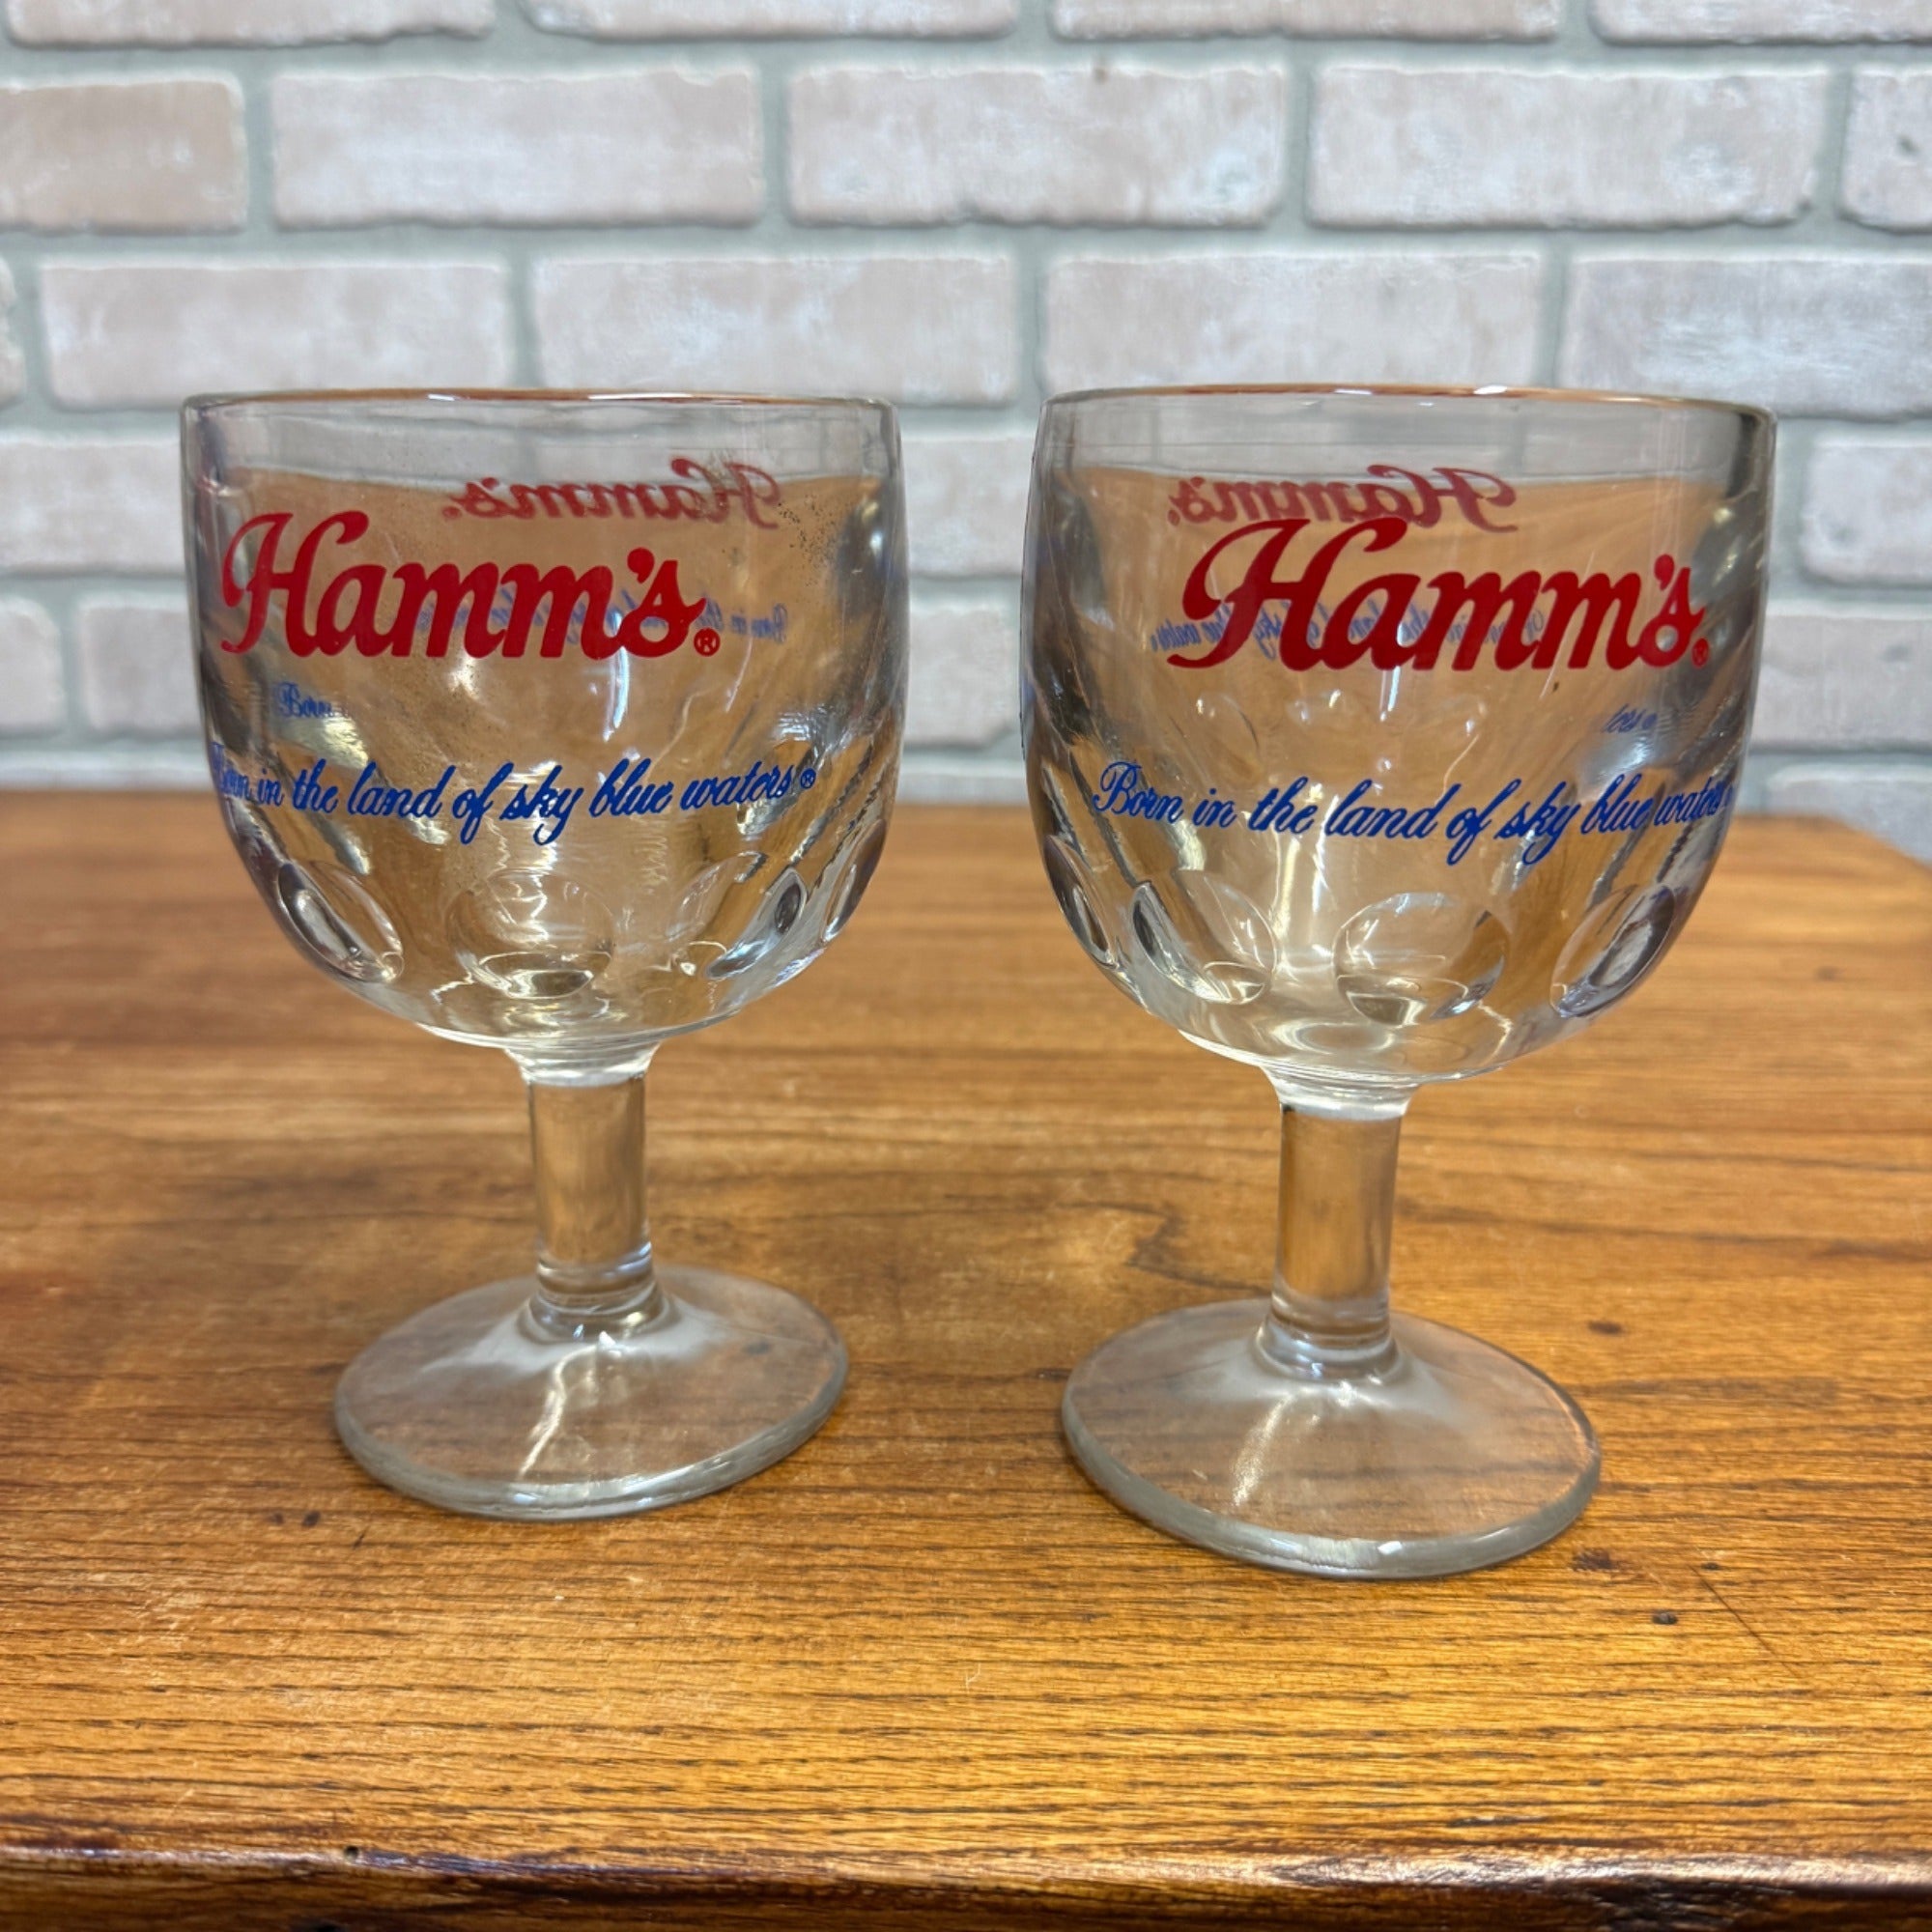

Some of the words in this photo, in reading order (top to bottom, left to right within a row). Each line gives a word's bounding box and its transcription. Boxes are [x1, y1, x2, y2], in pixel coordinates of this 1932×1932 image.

[257, 768, 285, 808] in
[292, 758, 338, 814] the
[347, 761, 456, 820] land
[451, 761, 515, 846] of
[498, 764, 584, 846] sky
[587, 757, 674, 818] blue
[1092, 759, 1184, 825] Born
[1192, 787, 1237, 829] in
[1246, 776, 1320, 835] the
[1323, 778, 1463, 840] land
[1445, 778, 1522, 867] of
[1493, 781, 1582, 866] sky
[1579, 773, 1656, 836] blue
